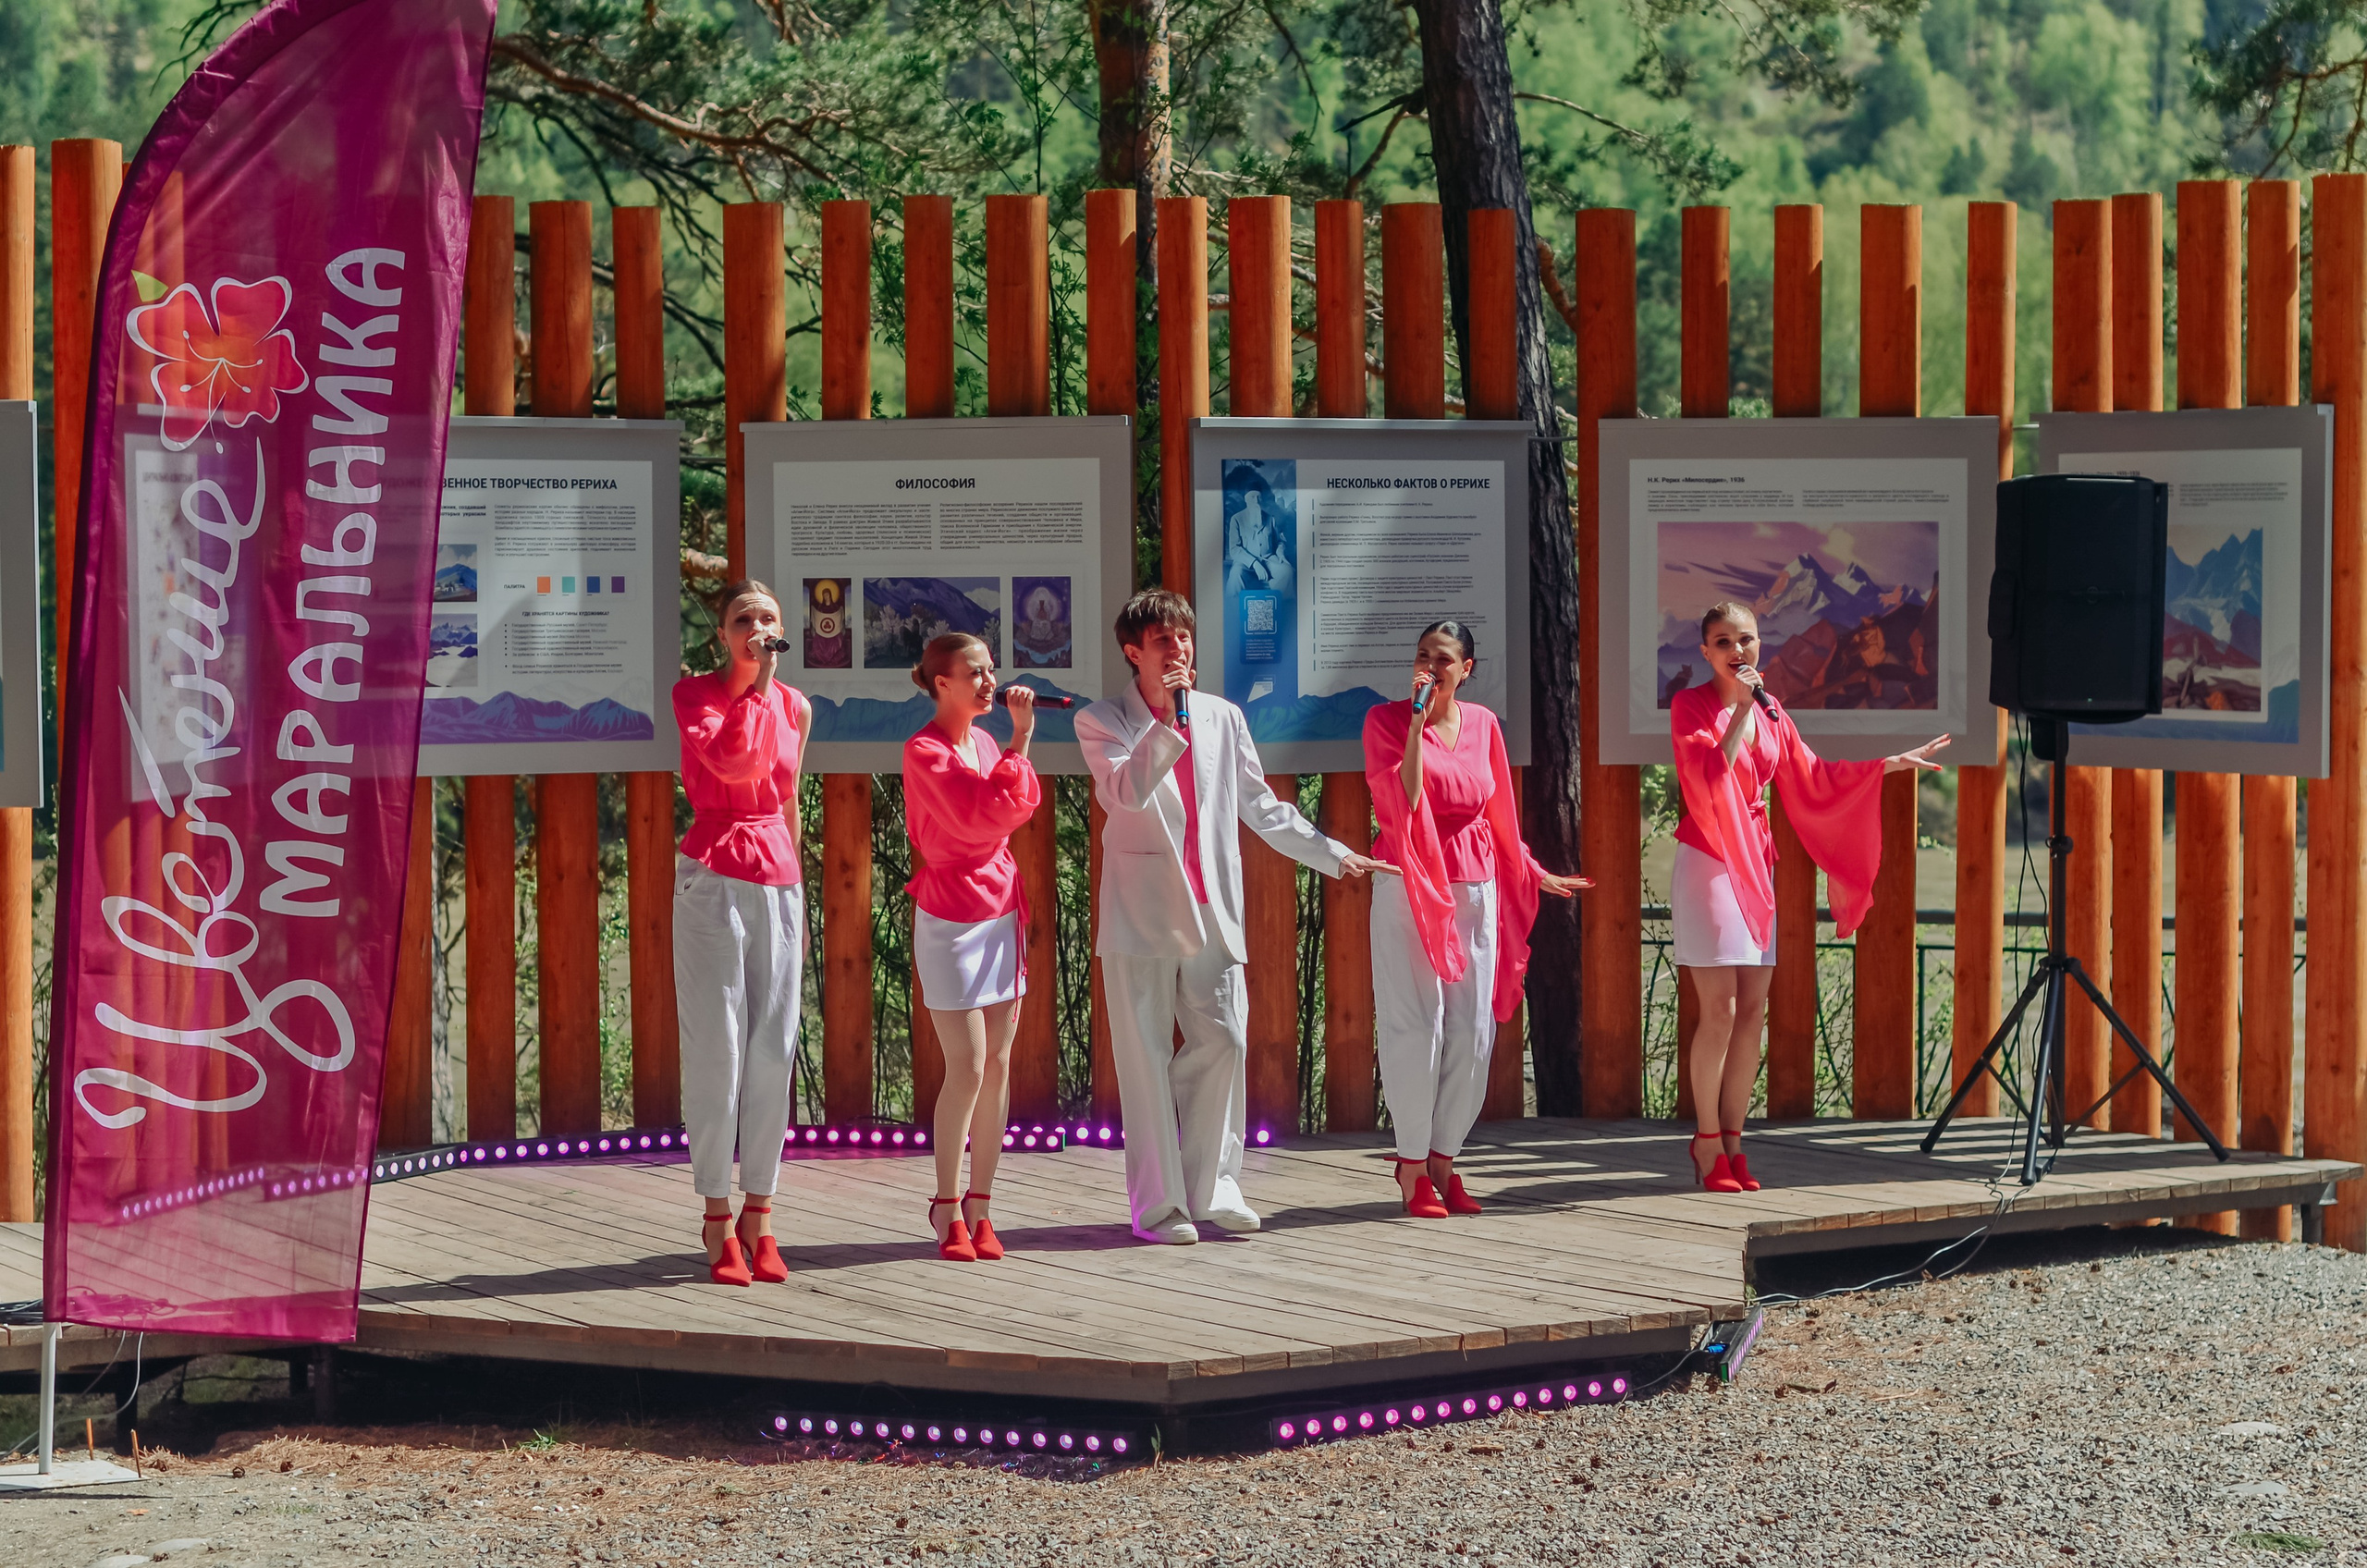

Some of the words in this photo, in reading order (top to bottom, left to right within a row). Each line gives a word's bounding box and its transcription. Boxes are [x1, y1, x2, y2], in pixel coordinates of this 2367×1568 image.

[490, 477, 568, 489] ТВОРЧЕСТВО
[571, 478, 618, 489] РЕРИХА
[895, 477, 975, 490] ФИЛОСОФИЯ
[1327, 477, 1392, 489] НЕСКОЛЬКО
[1394, 478, 1438, 489] ФАКТОВ
[1440, 478, 1448, 489] О
[1450, 478, 1490, 489] РЕРИХЕ
[1662, 476, 1681, 484] Рерих
[260, 247, 406, 917] МАРАЛЬНИКА
[74, 435, 356, 1129] Цветение
